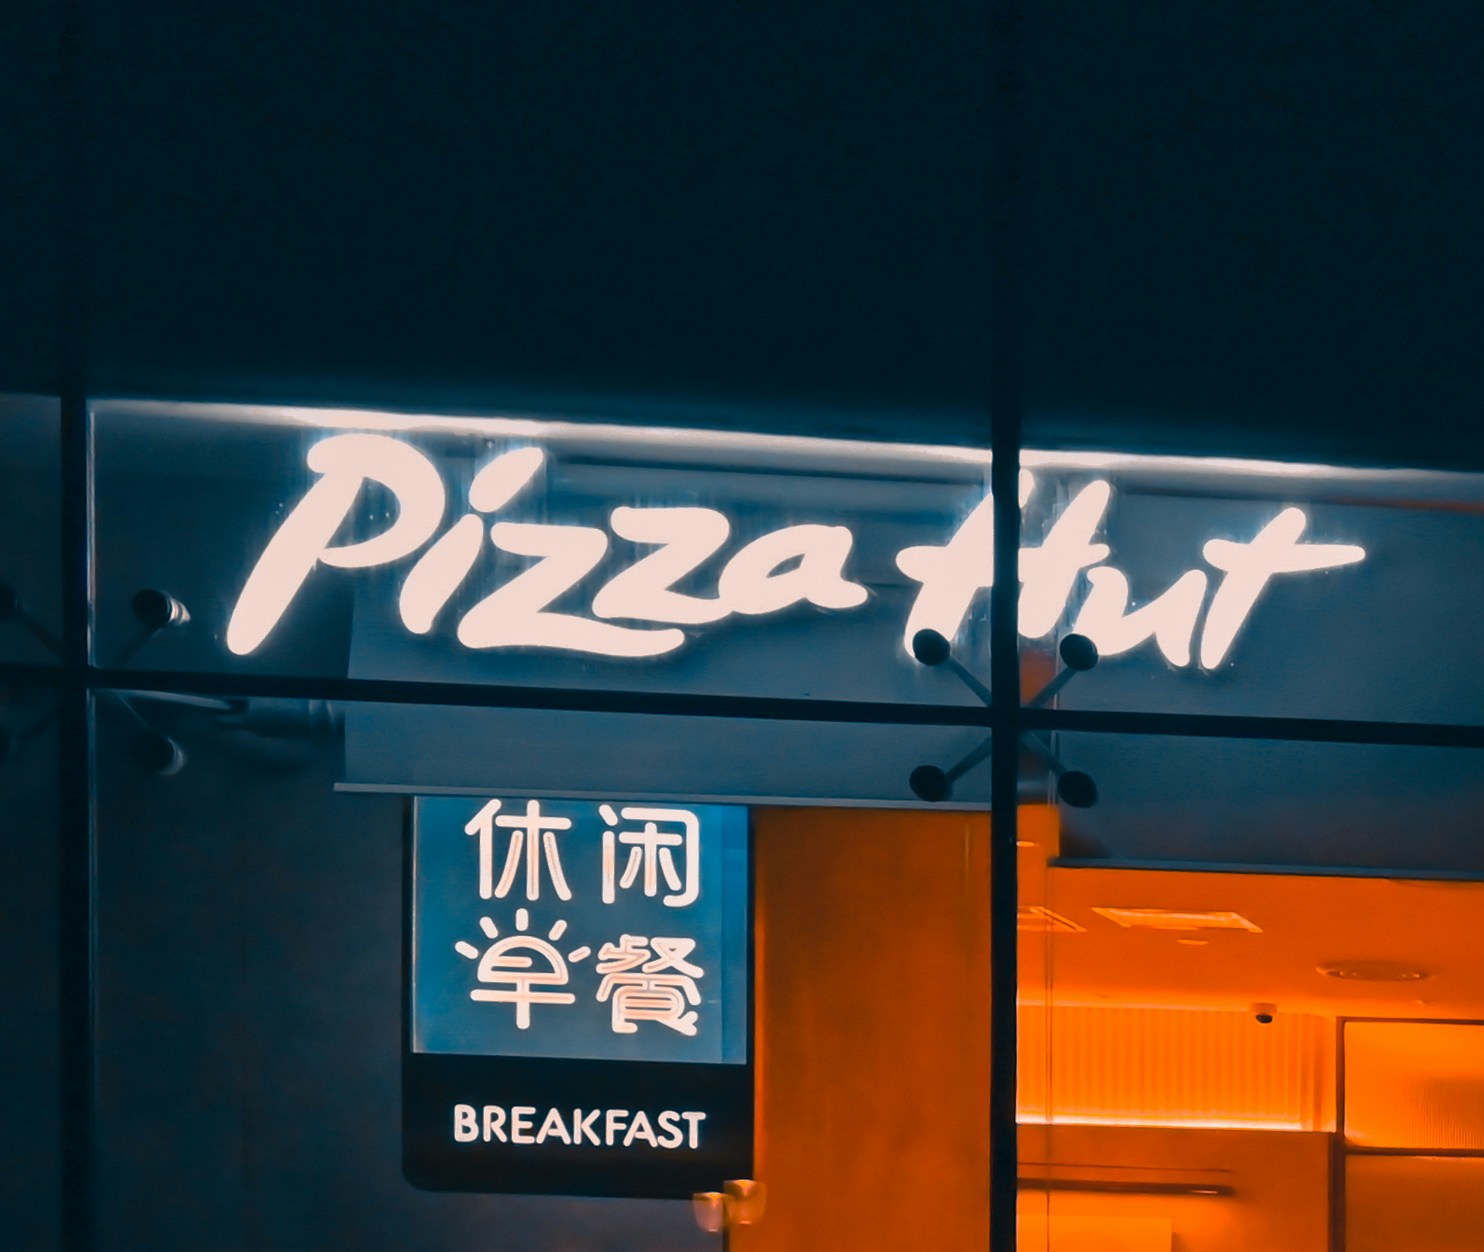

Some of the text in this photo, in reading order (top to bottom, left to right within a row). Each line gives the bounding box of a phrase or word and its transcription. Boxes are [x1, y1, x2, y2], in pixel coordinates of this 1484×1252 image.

[227, 433, 1366, 669] Pizza Hut
[464, 799, 700, 907] 休闲
[455, 909, 706, 1036] 早餐
[453, 1103, 707, 1150] BREAKFAST
